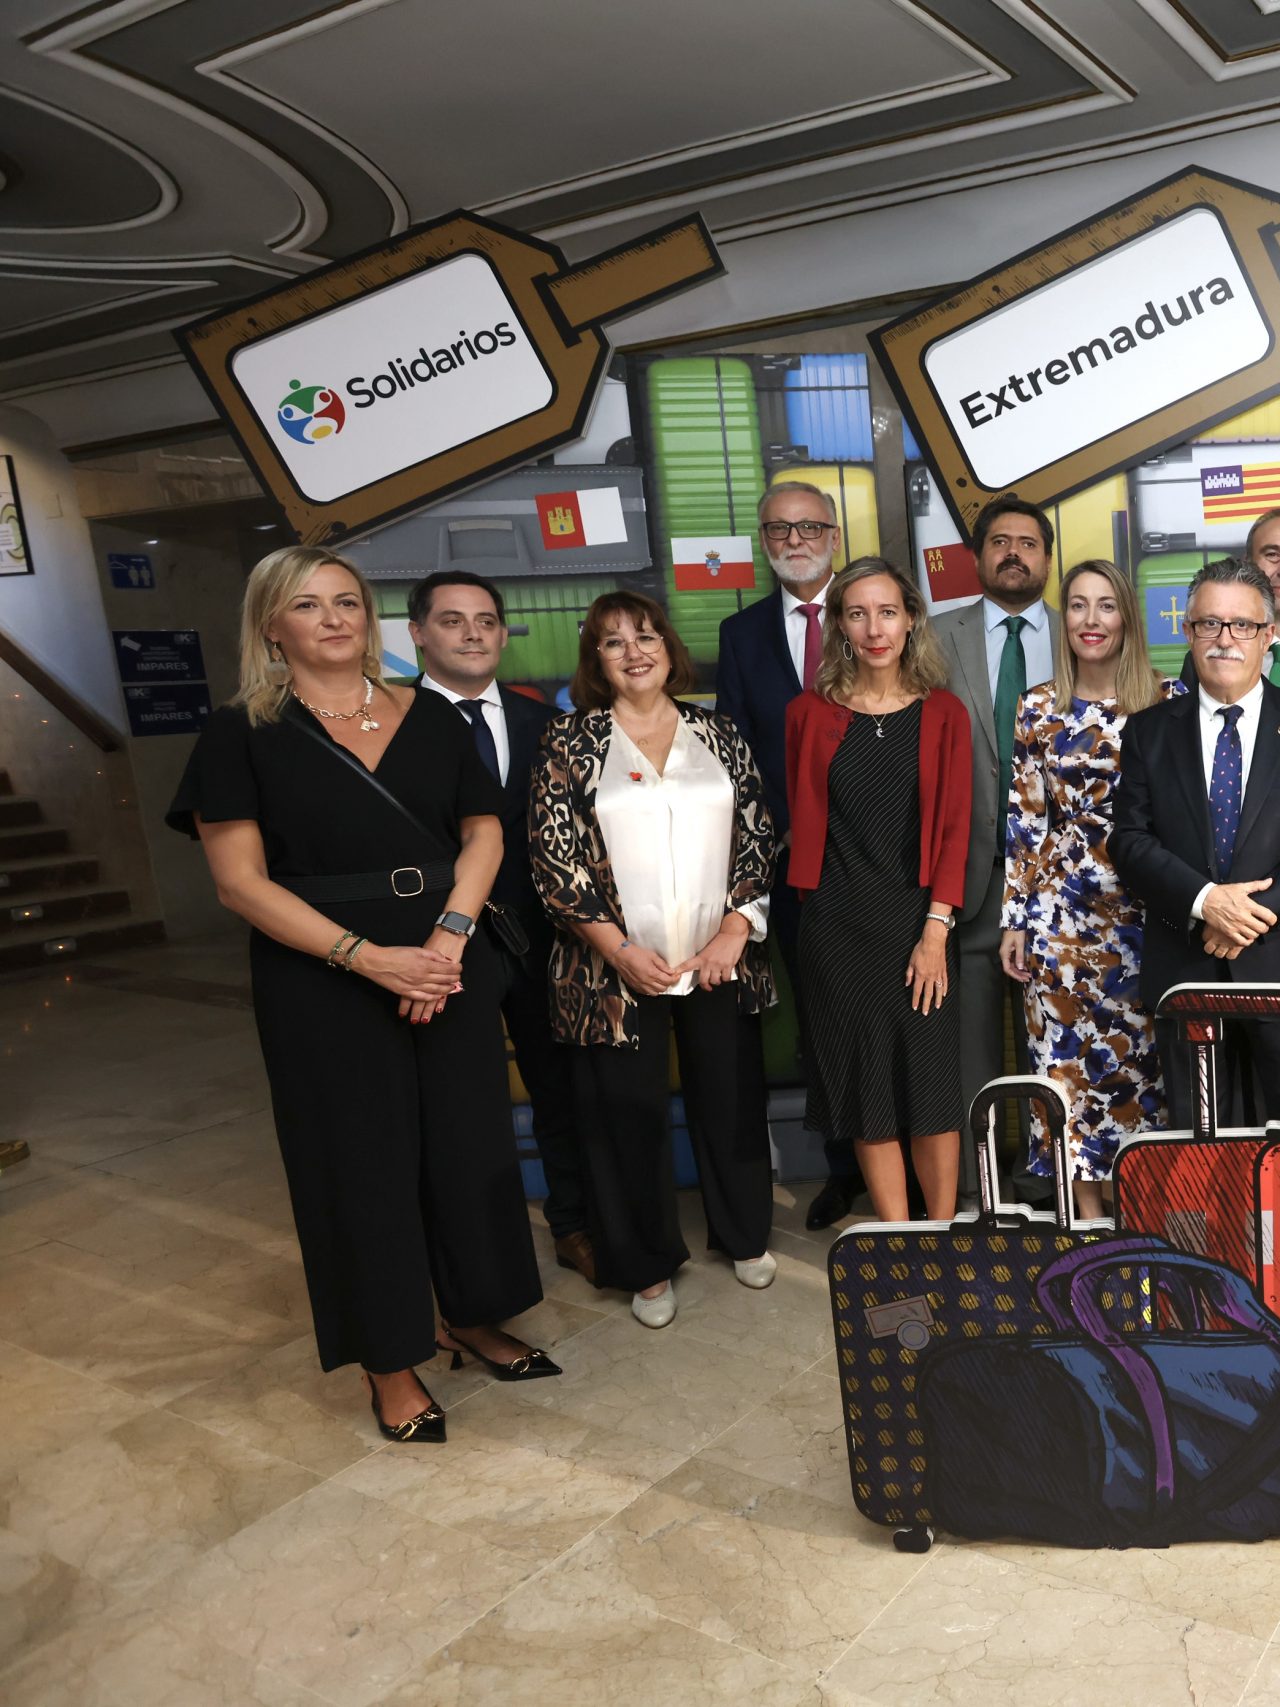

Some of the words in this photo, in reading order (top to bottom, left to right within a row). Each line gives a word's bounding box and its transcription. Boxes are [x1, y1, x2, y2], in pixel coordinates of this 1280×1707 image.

[346, 322, 516, 408] Solidarios
[959, 276, 1235, 429] Extremadura
[136, 662, 189, 672] IMPARES
[140, 711, 193, 722] IMPARES
